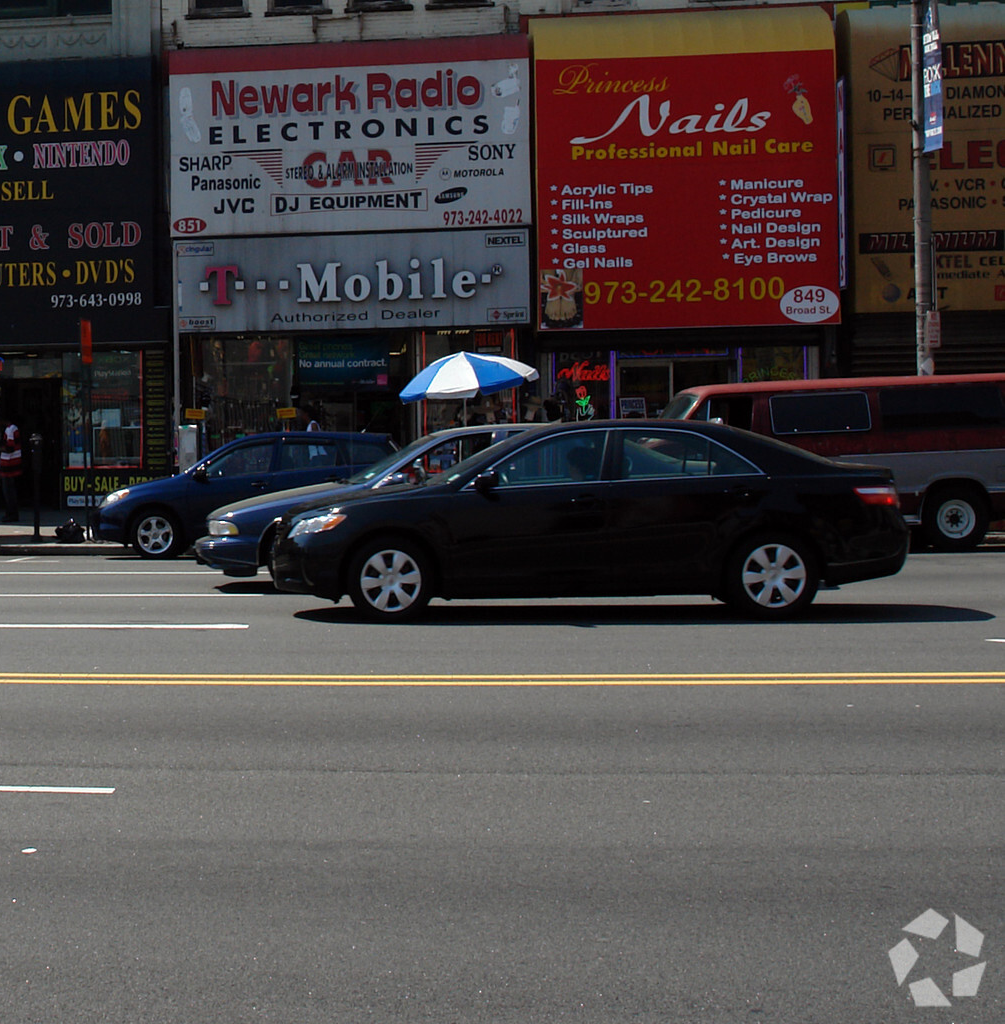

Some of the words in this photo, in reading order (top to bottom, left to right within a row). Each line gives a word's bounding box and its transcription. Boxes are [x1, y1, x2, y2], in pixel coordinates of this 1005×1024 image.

[552, 62, 671, 96] Princess
[210, 74, 357, 118] Newark
[366, 68, 482, 112] Radio
[7, 89, 143, 136] GAMES
[569, 94, 772, 145] Nails
[208, 114, 490, 146] ELECTRONICS
[32, 138, 131, 170] NINTENDO
[468, 144, 517, 161] SONY
[571, 141, 704, 161] Professional
[712, 138, 757, 157] Nail
[764, 138, 815, 155] Care
[179, 155, 233, 172] SHARP
[285, 165, 315, 180] STEREO
[317, 164, 324, 180] &
[326, 162, 355, 180] ALARM
[356, 161, 414, 179] INSTALLATION
[302, 149, 395, 189] CAR
[453, 168, 505, 179] MOTOROLA
[0, 179, 55, 202] SELL
[191, 175, 262, 192] Panasonic
[561, 183, 617, 198] Acrylic
[620, 182, 654, 197] Tips
[730, 178, 805, 191] Manicure
[954, 178, 986, 191] VCR
[213, 197, 256, 215] JVC
[275, 196, 300, 214] DJ
[309, 191, 423, 211] EQUIPMENT
[561, 198, 614, 211] Fill-Ins
[730, 191, 787, 207] Crystal
[791, 191, 834, 207] Wrap
[898, 196, 987, 211] PAASONIC
[443, 208, 523, 226] 973-242-4022
[561, 213, 591, 226] Silk
[594, 213, 645, 228] Wraps
[731, 207, 802, 220] Pedicure
[178, 218, 206, 232] 851
[561, 226, 649, 241] Sculptured
[731, 222, 762, 235] Nail
[766, 222, 822, 237] Design
[28, 224, 50, 250] &
[67, 220, 142, 249] SOLD
[487, 235, 524, 245] NEXTEL
[731, 237, 761, 250] Art.
[765, 236, 821, 251] Design
[562, 242, 607, 255] Glass
[563, 257, 590, 270] Gel
[594, 256, 634, 269] Nails
[734, 252, 764, 267] Eye
[767, 251, 818, 264] Brows
[75, 258, 136, 286] DVD'S
[583, 276, 786, 306] 973-242-8100
[793, 288, 826, 304] 849
[50, 292, 143, 309] 973-643-0998
[270, 310, 369, 325] Authorized
[381, 307, 441, 322] Dealer
[503, 310, 526, 321] Sprint
[785, 305, 816, 315] Broad
[818, 304, 832, 315] St.
[298, 358, 313, 369] No
[313, 358, 345, 369] annual
[346, 357, 388, 369] contract.
[557, 360, 610, 382] Nails
[63, 475, 86, 492] BUY
[94, 475, 120, 492] SALE
